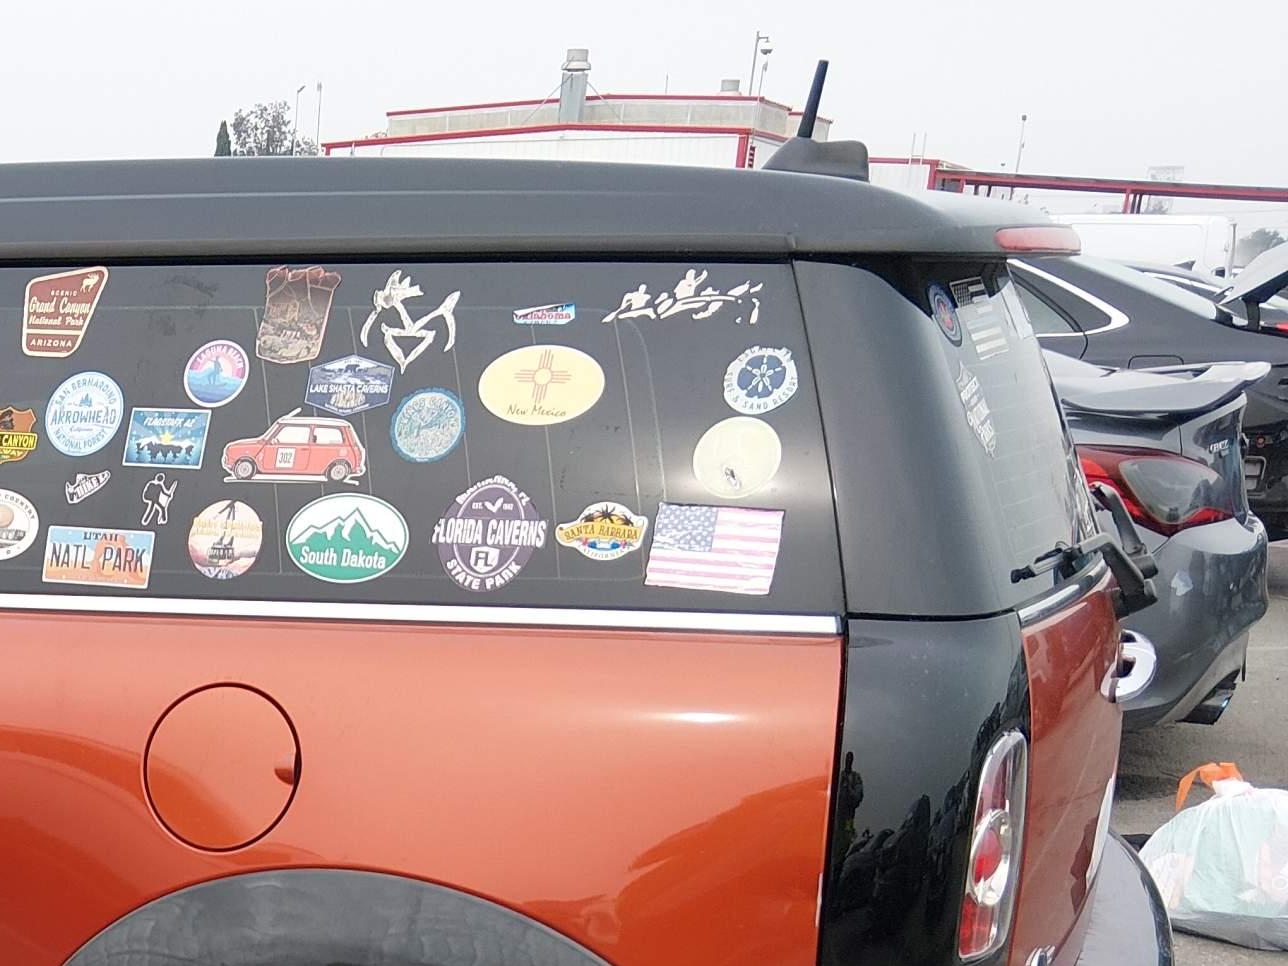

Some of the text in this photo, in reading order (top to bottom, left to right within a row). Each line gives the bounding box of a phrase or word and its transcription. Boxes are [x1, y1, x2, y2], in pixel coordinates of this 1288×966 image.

[29, 296, 91, 317] Grand Canyon
[28, 315, 84, 326] National Park
[30, 338, 72, 347] ARIZONA
[54, 377, 117, 406] SAN BERNARDINO
[310, 383, 389, 394] LAKE SHASTA CAVERNS
[50, 406, 117, 426] ARROWHEAD
[506, 402, 567, 418] New Mexico
[2, 434, 35, 448] CANYON
[278, 451, 293, 464] 302
[83, 531, 119, 542] UTAH
[431, 518, 548, 548] FLORIDA CAVERNS
[564, 524, 638, 541] SANTA BARBARA
[49, 542, 147, 573] NATL PARK
[300, 546, 387, 569] South Dakota
[446, 559, 521, 590] STATE PARK
